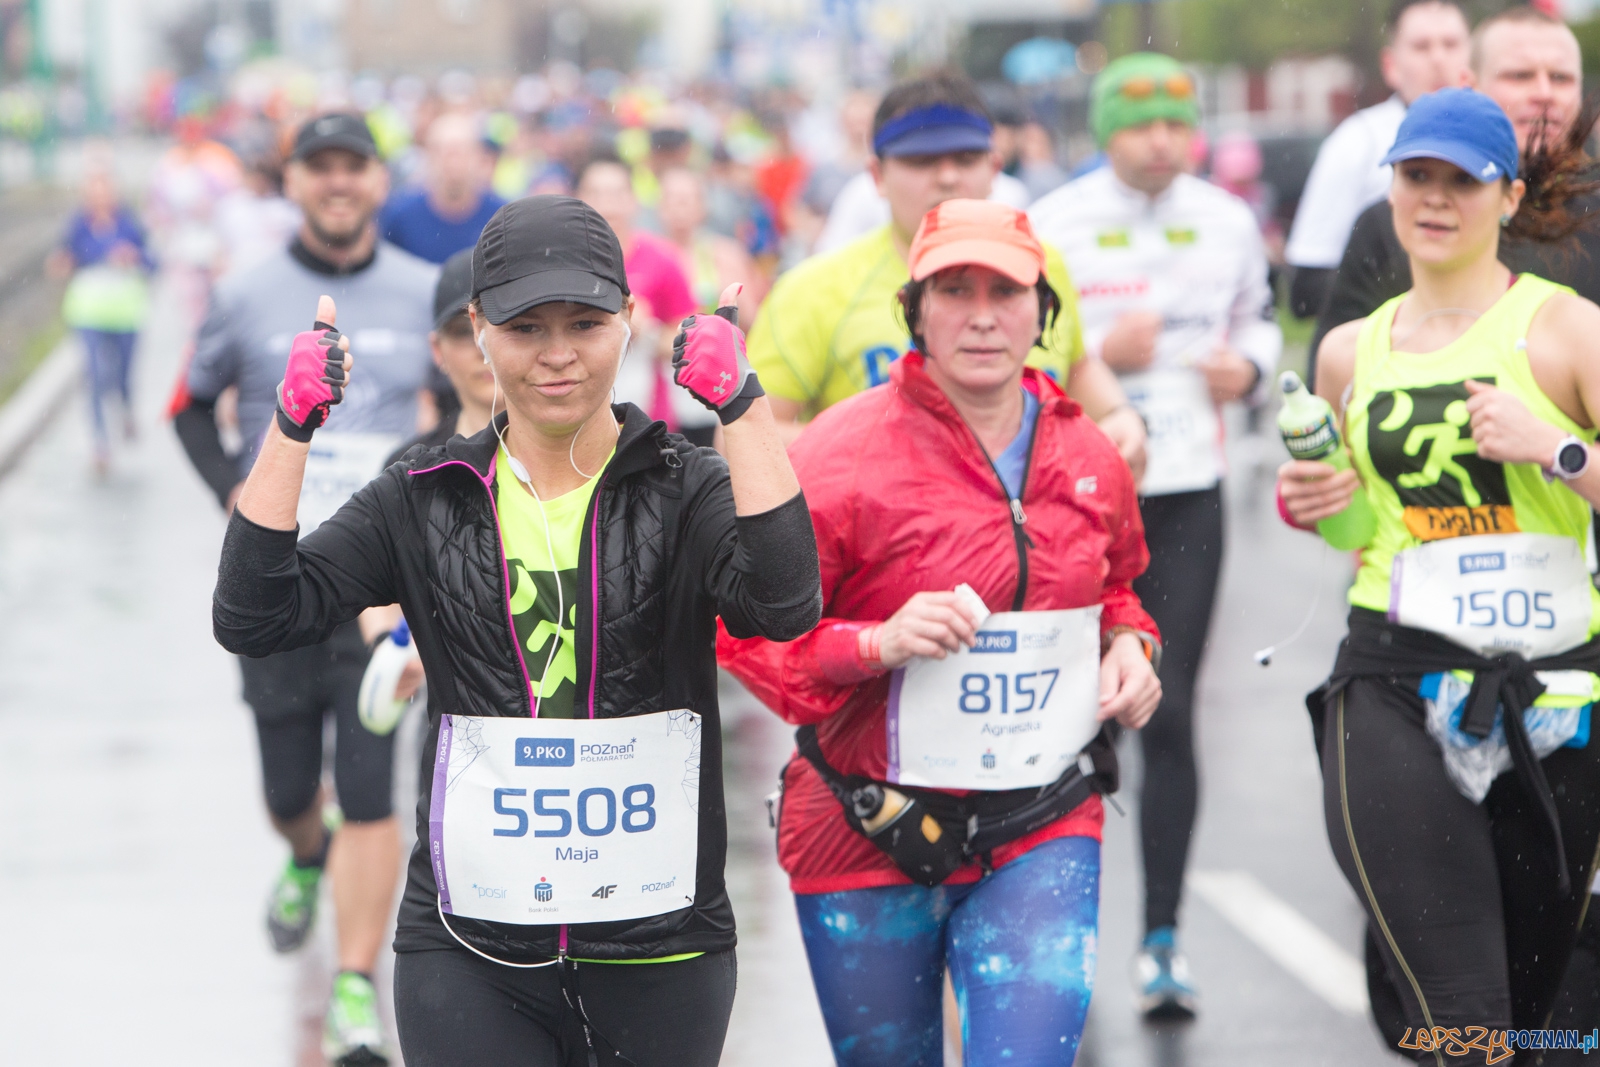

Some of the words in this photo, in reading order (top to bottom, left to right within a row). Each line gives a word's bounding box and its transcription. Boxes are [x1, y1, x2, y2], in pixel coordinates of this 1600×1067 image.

[1453, 590, 1556, 630] 1505
[958, 668, 1060, 714] 8157
[981, 721, 1042, 737] Agnieszka
[493, 783, 656, 838] 5508
[555, 847, 599, 863] Maja
[591, 884, 618, 899] 4F
